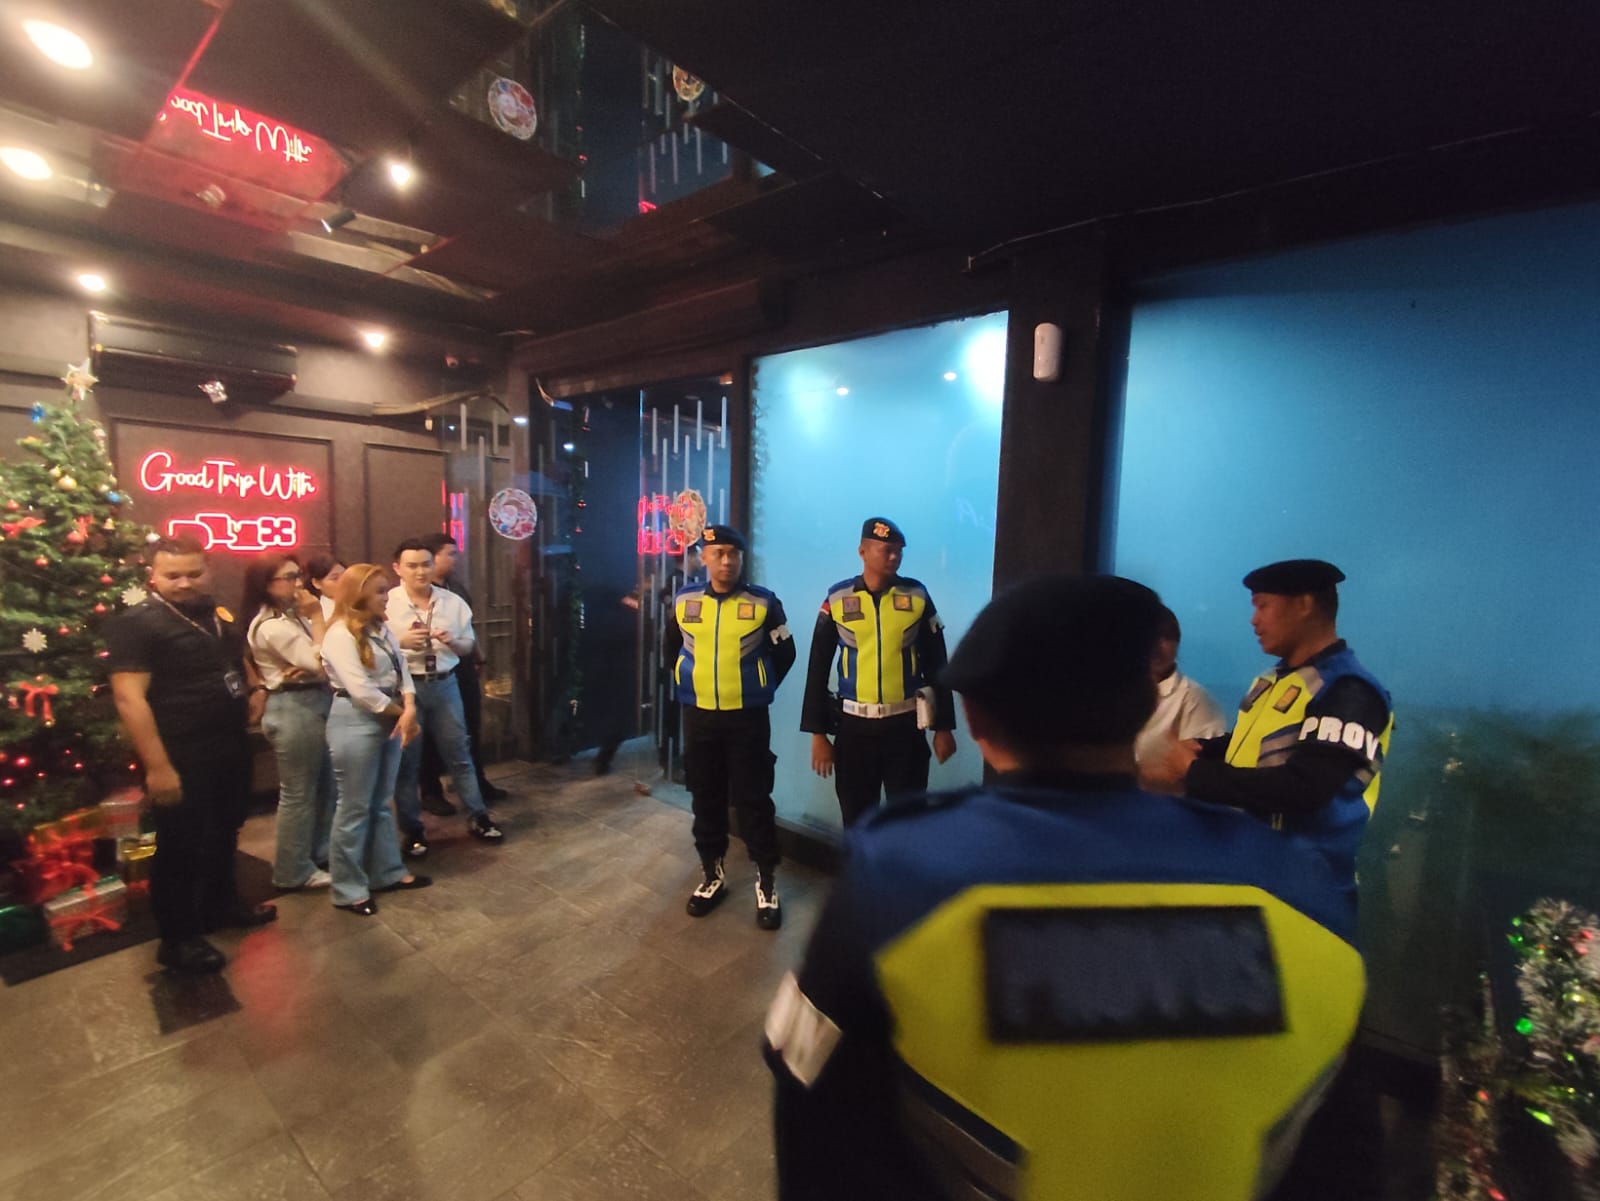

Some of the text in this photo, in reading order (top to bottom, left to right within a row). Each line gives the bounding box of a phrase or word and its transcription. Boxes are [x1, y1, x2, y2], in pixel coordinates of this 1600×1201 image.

[140, 451, 316, 500] Good Trip With
